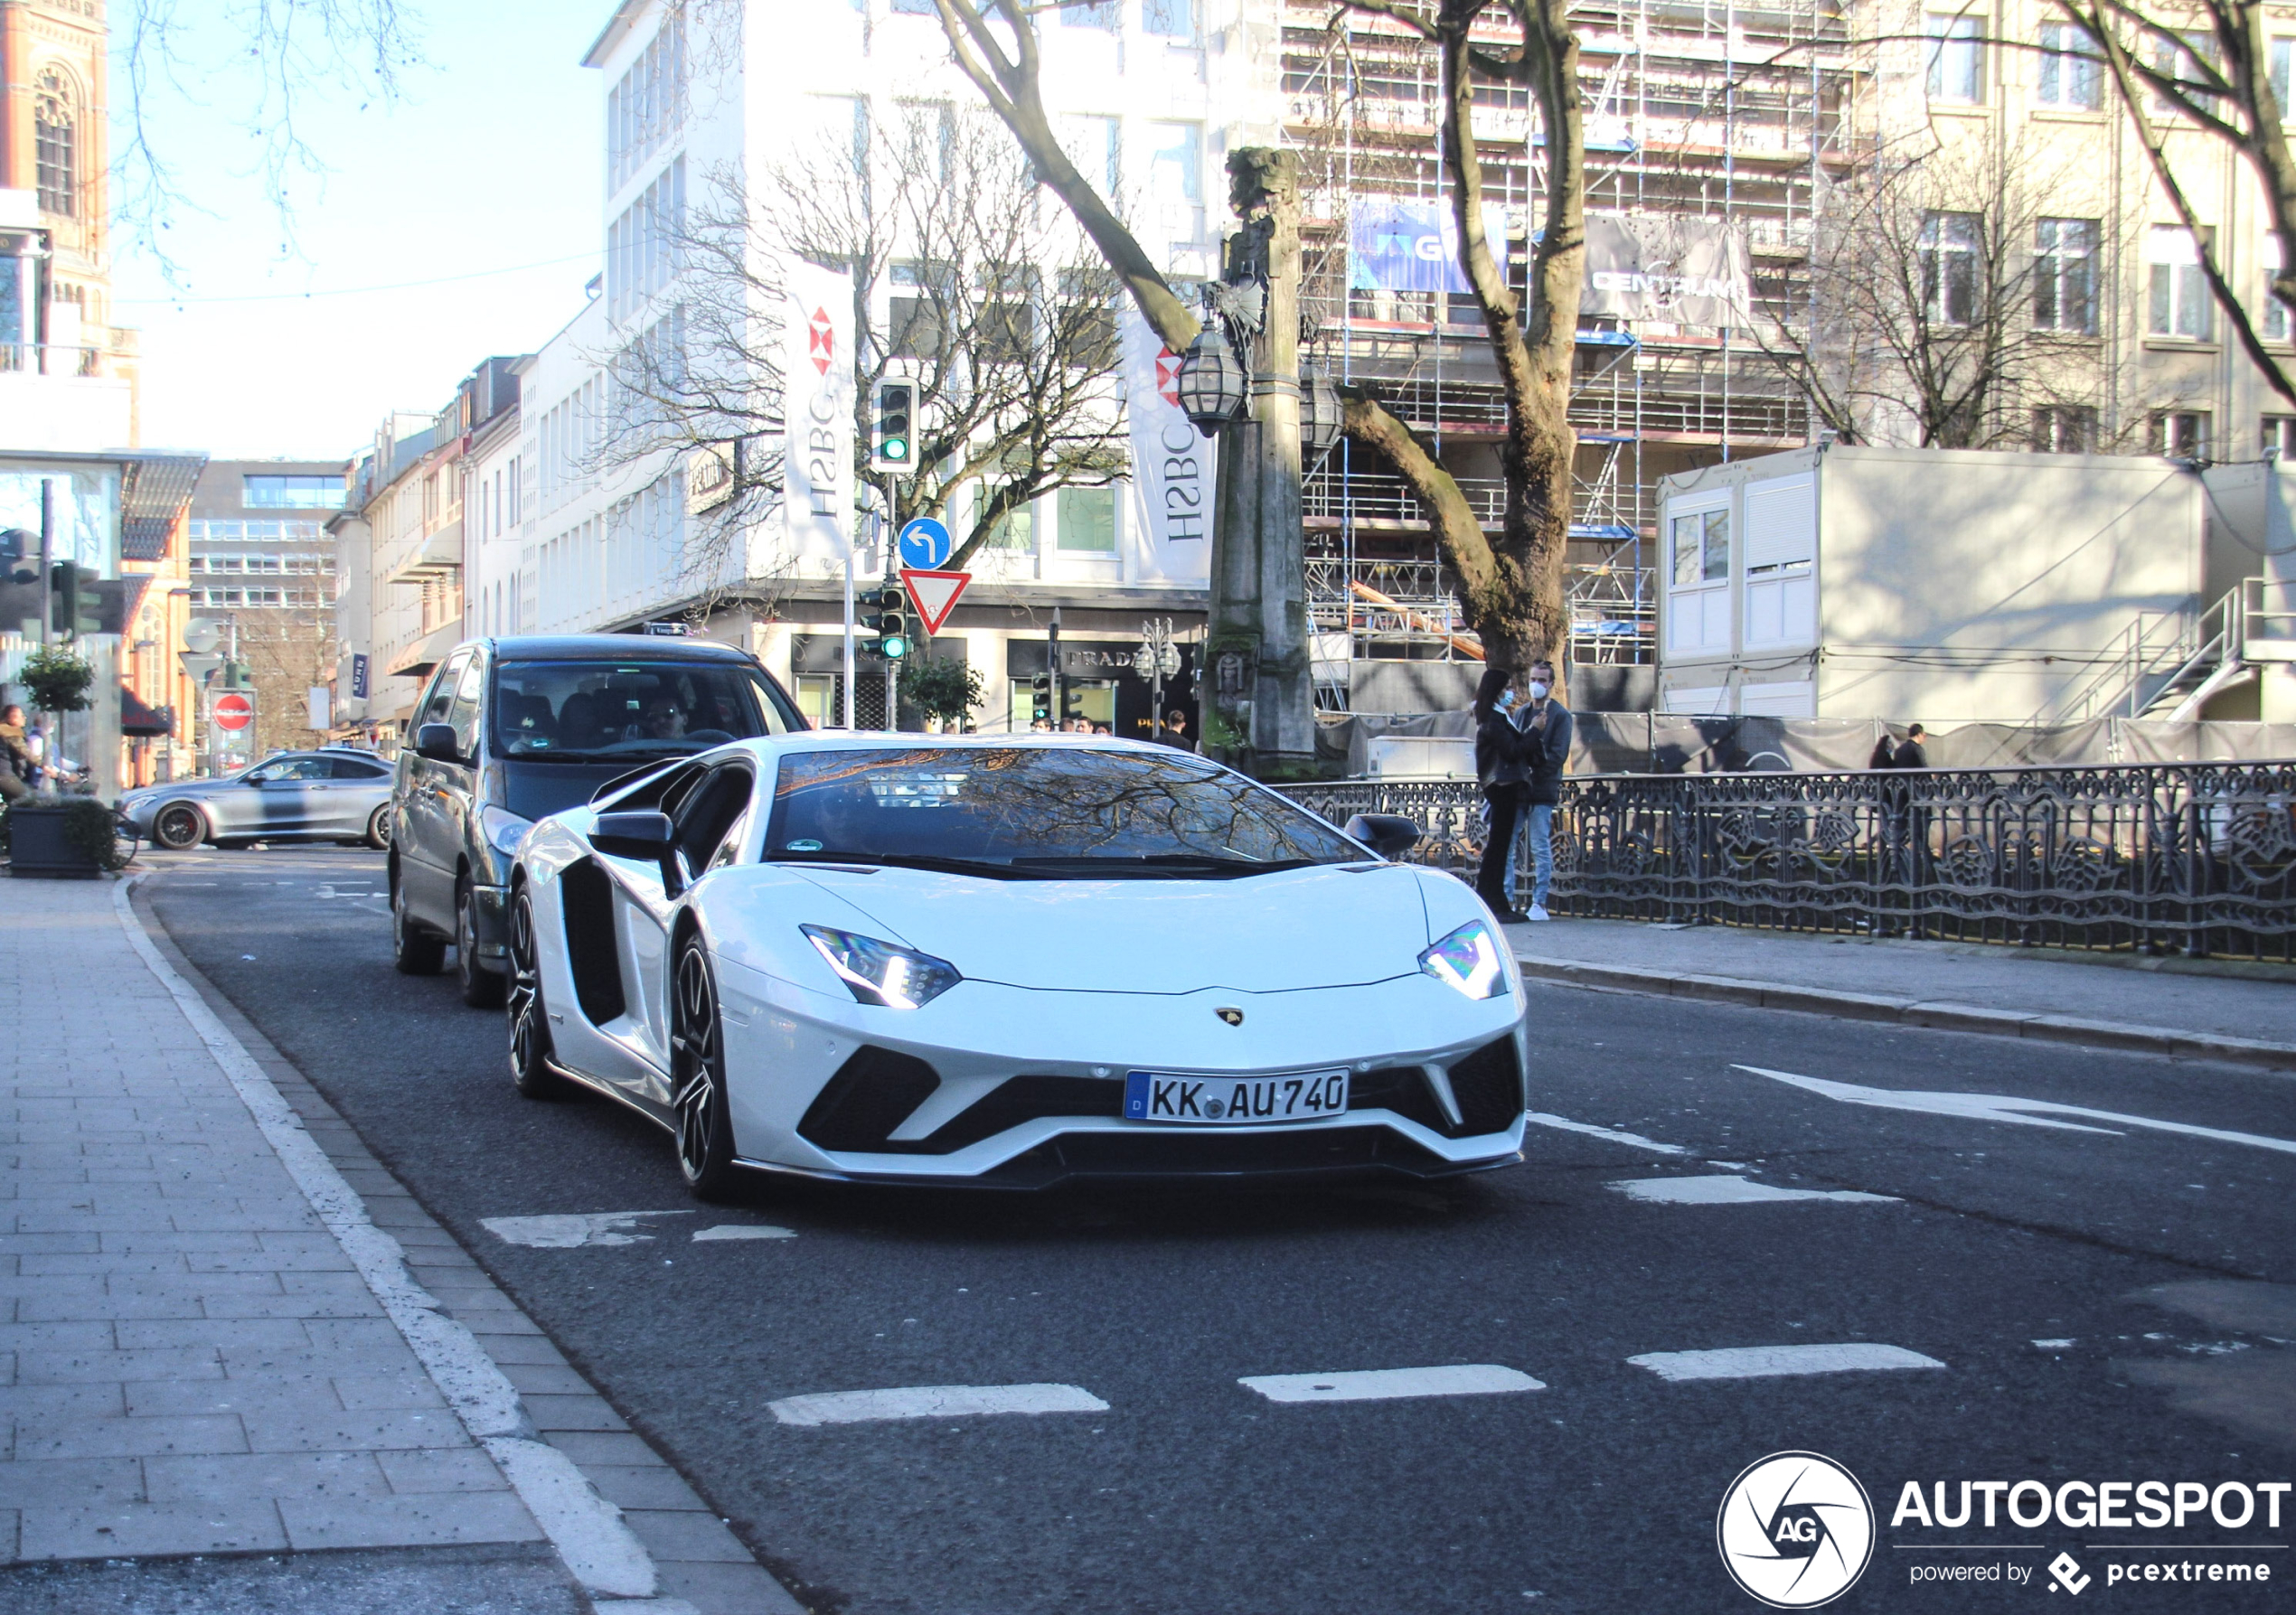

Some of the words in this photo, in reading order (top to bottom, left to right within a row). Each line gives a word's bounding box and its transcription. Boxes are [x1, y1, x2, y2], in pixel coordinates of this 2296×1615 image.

[1592, 271, 1738, 299] CENTRUM
[1137, 718, 1167, 728] PRA
[1152, 1080, 1204, 1117] KK
[1227, 1082, 1275, 1117] AU
[1282, 1074, 1343, 1112] 740
[1132, 1100, 1142, 1111] D
